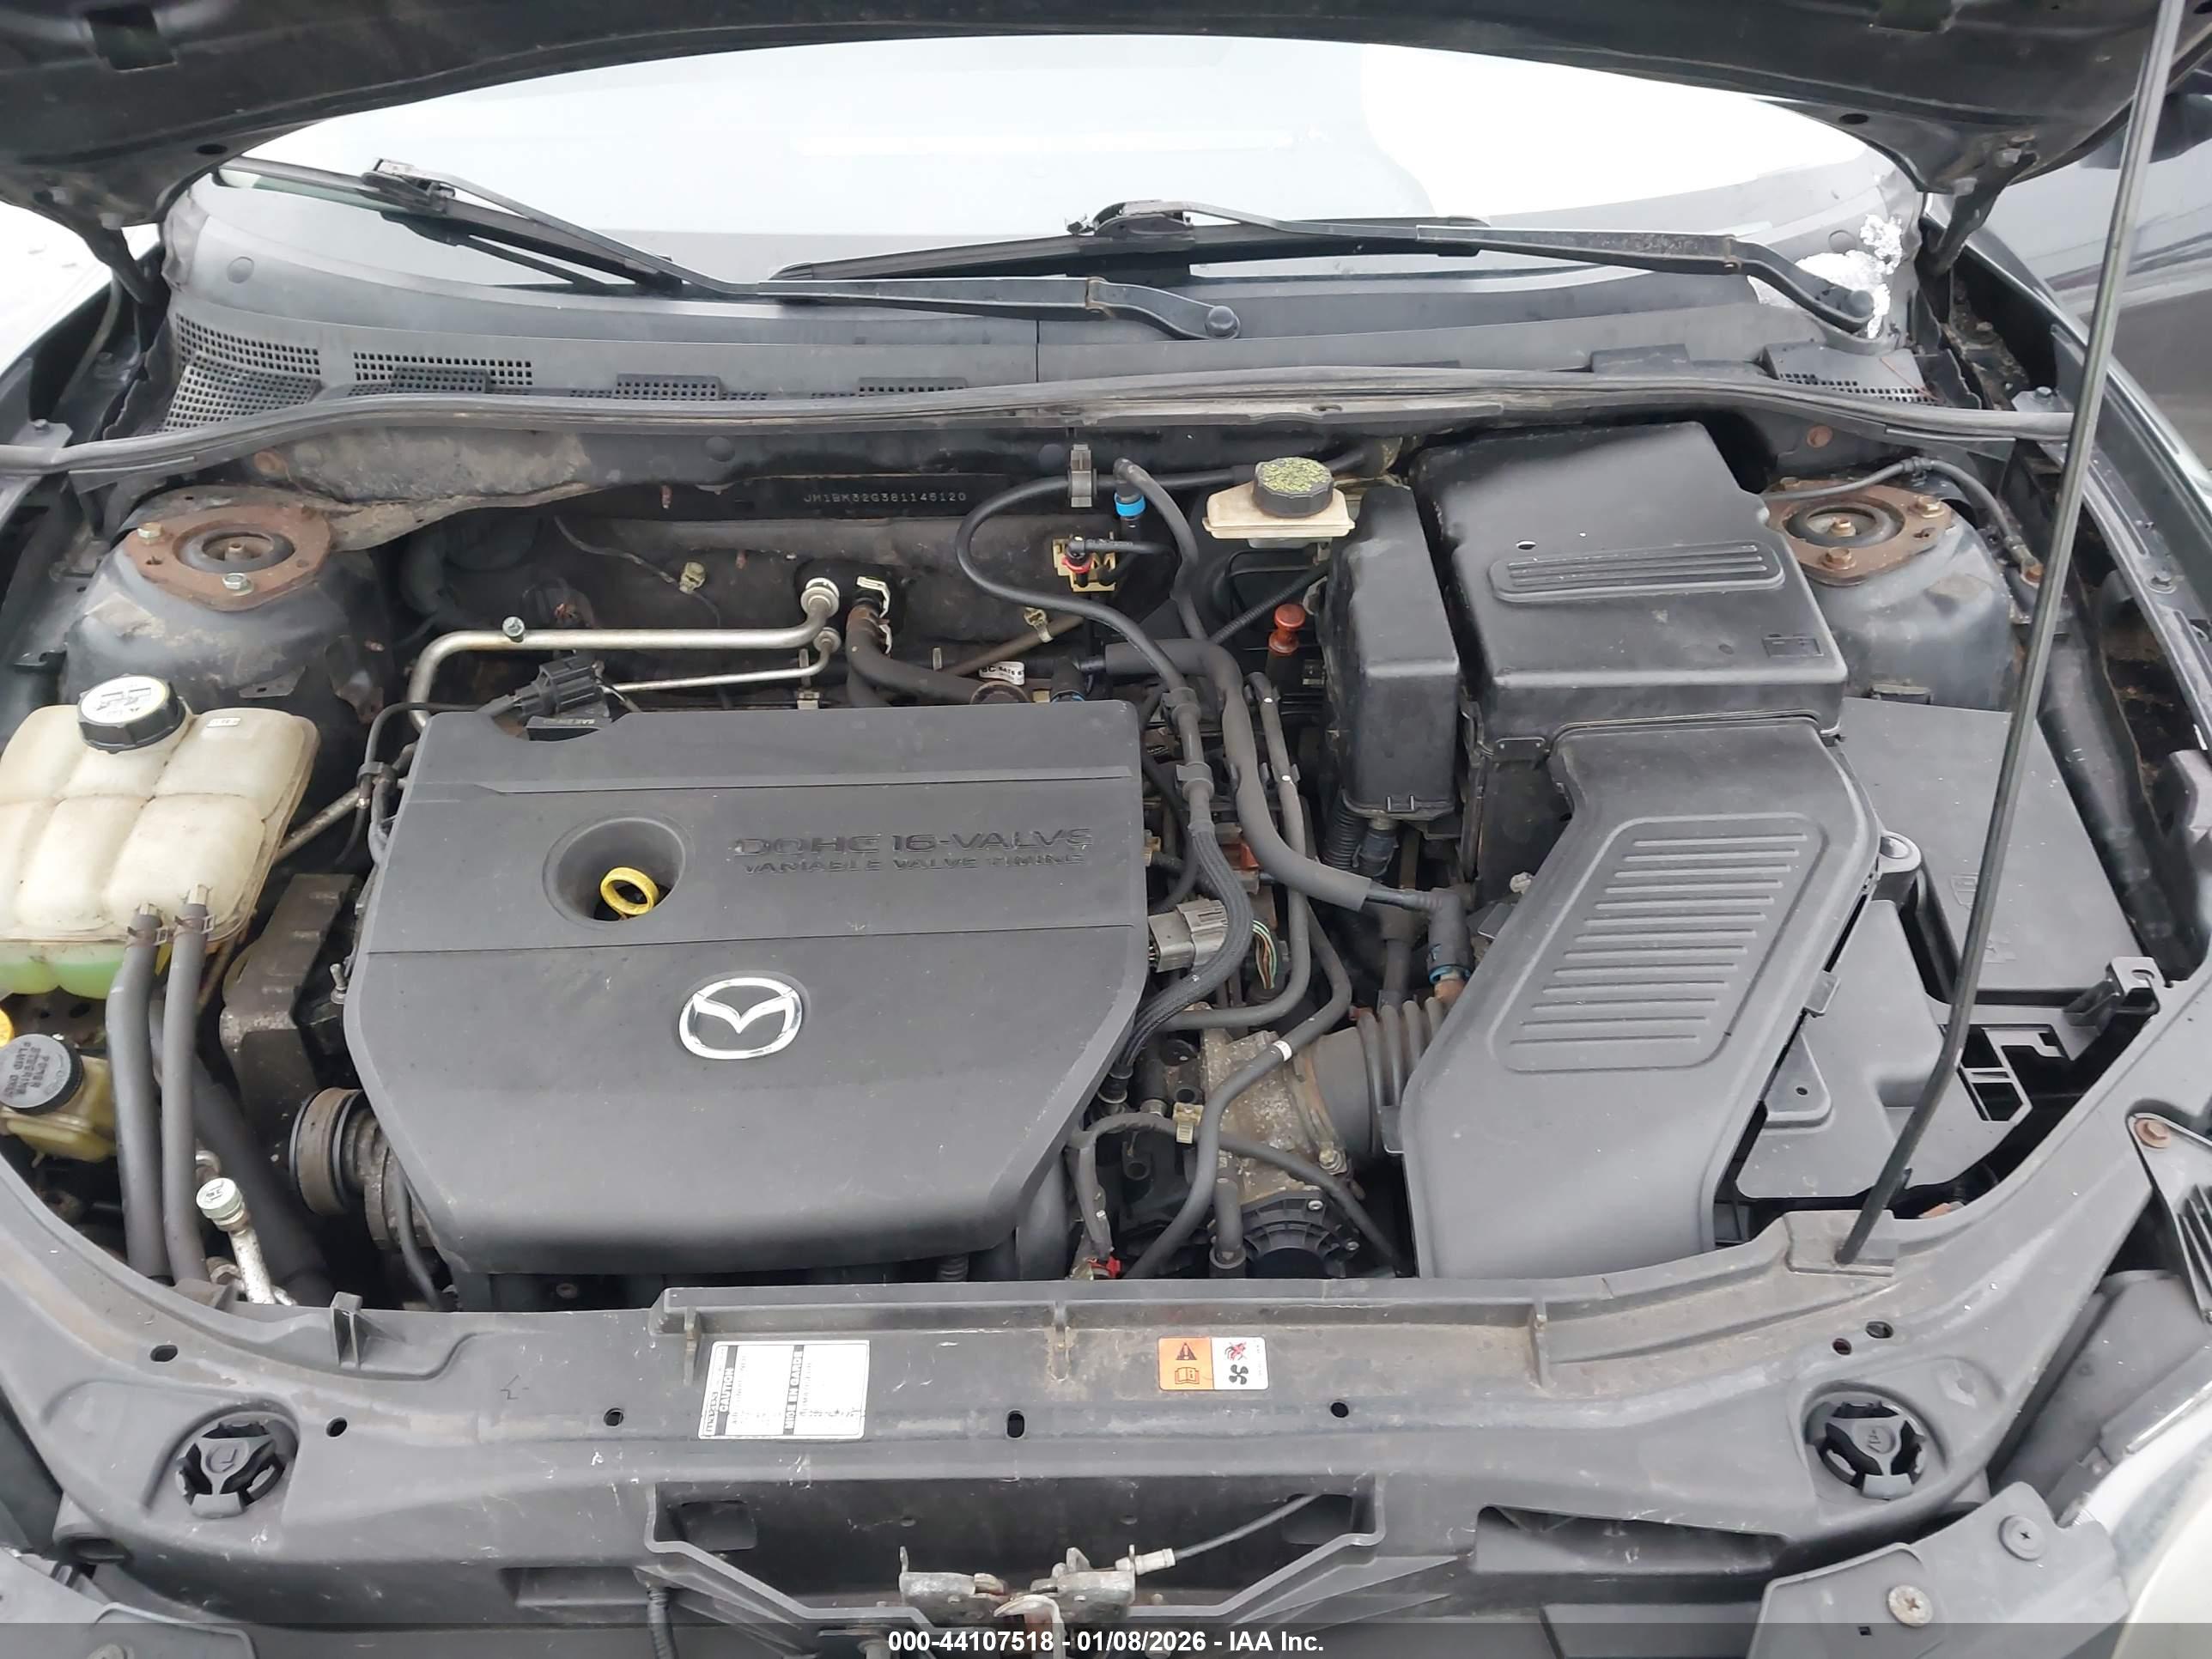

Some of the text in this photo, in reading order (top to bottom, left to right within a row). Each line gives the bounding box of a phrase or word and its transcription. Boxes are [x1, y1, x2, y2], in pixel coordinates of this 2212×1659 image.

[804, 492, 967, 502] JM1BK32G381145120
[734, 828, 1093, 856] DOHC 16-VALVE
[744, 860, 883, 875] VARIABLE
[892, 857, 978, 871] VALVE
[789, 1350, 804, 1387] GARDE
[719, 1366, 735, 1413] CAUTION
